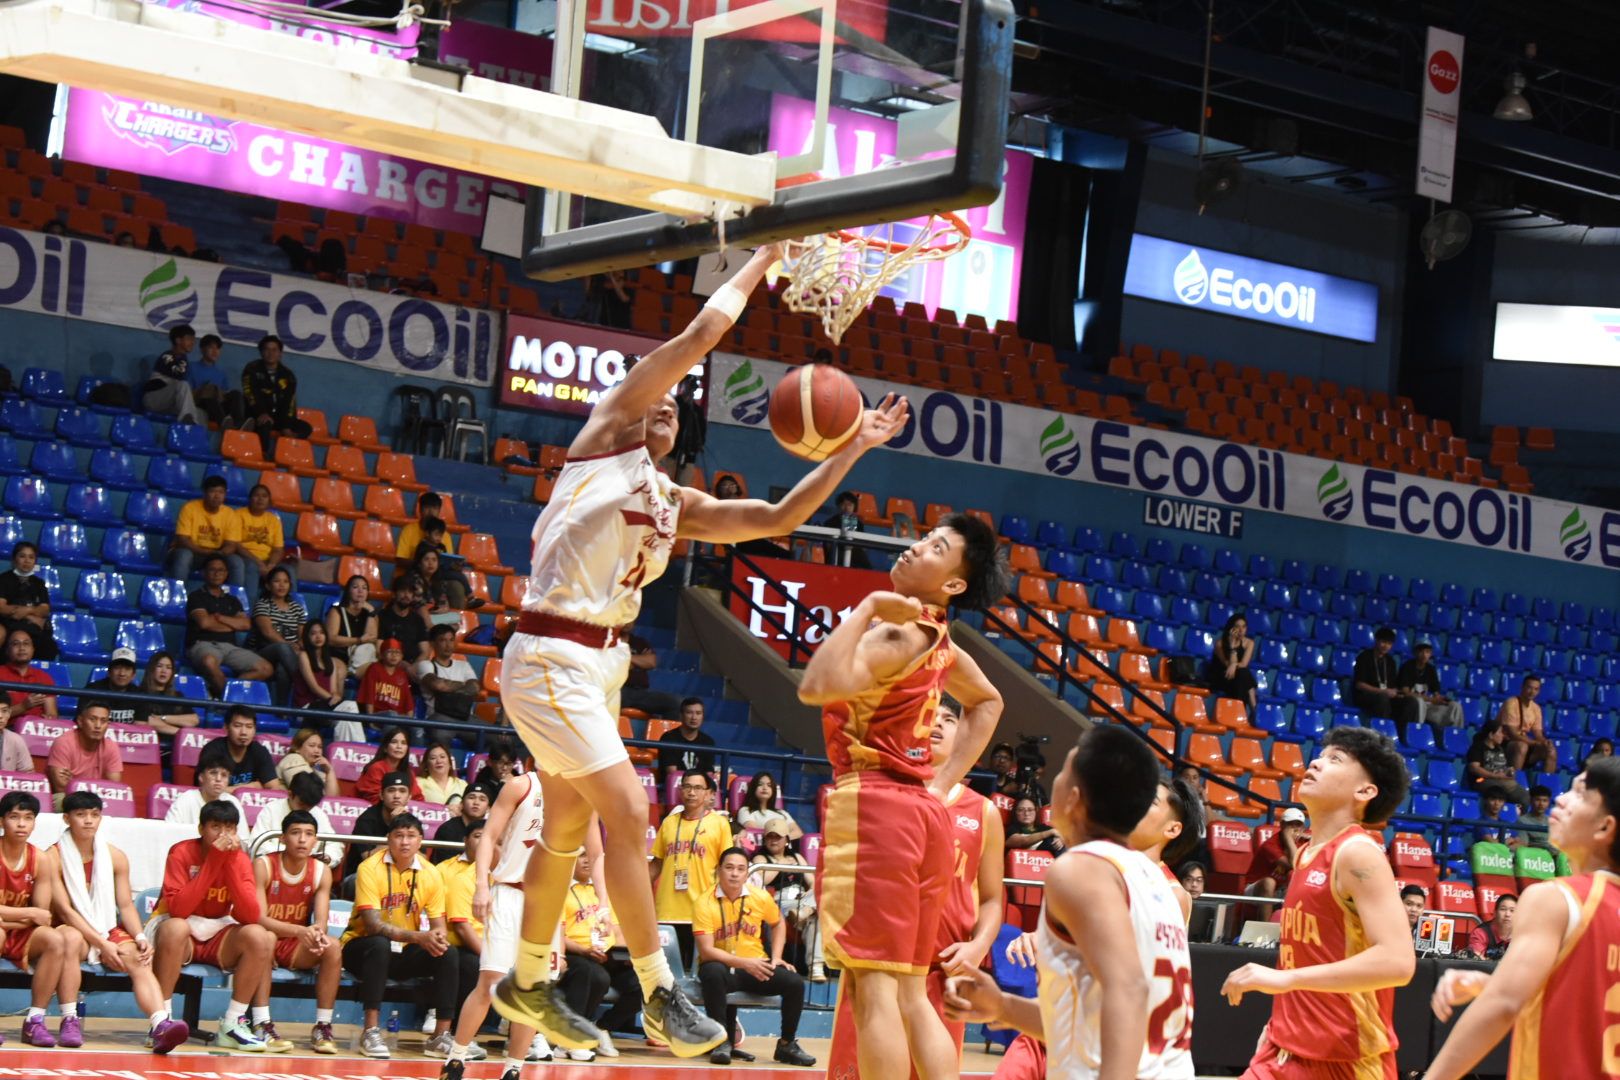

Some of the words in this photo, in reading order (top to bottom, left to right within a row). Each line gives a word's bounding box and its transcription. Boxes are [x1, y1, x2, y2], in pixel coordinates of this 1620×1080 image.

[1430, 64, 1457, 81] Gazz
[1210, 267, 1316, 323] EcoOil
[214, 267, 490, 382] EcoOil
[1091, 420, 1286, 512] EcoOil
[1144, 497, 1222, 534] LOWER
[1228, 510, 1243, 537] F
[1362, 469, 1532, 553] EcoOil
[1213, 824, 1252, 841] Hanes
[1396, 842, 1433, 857] Hanes
[1440, 884, 1475, 900] Hanes
